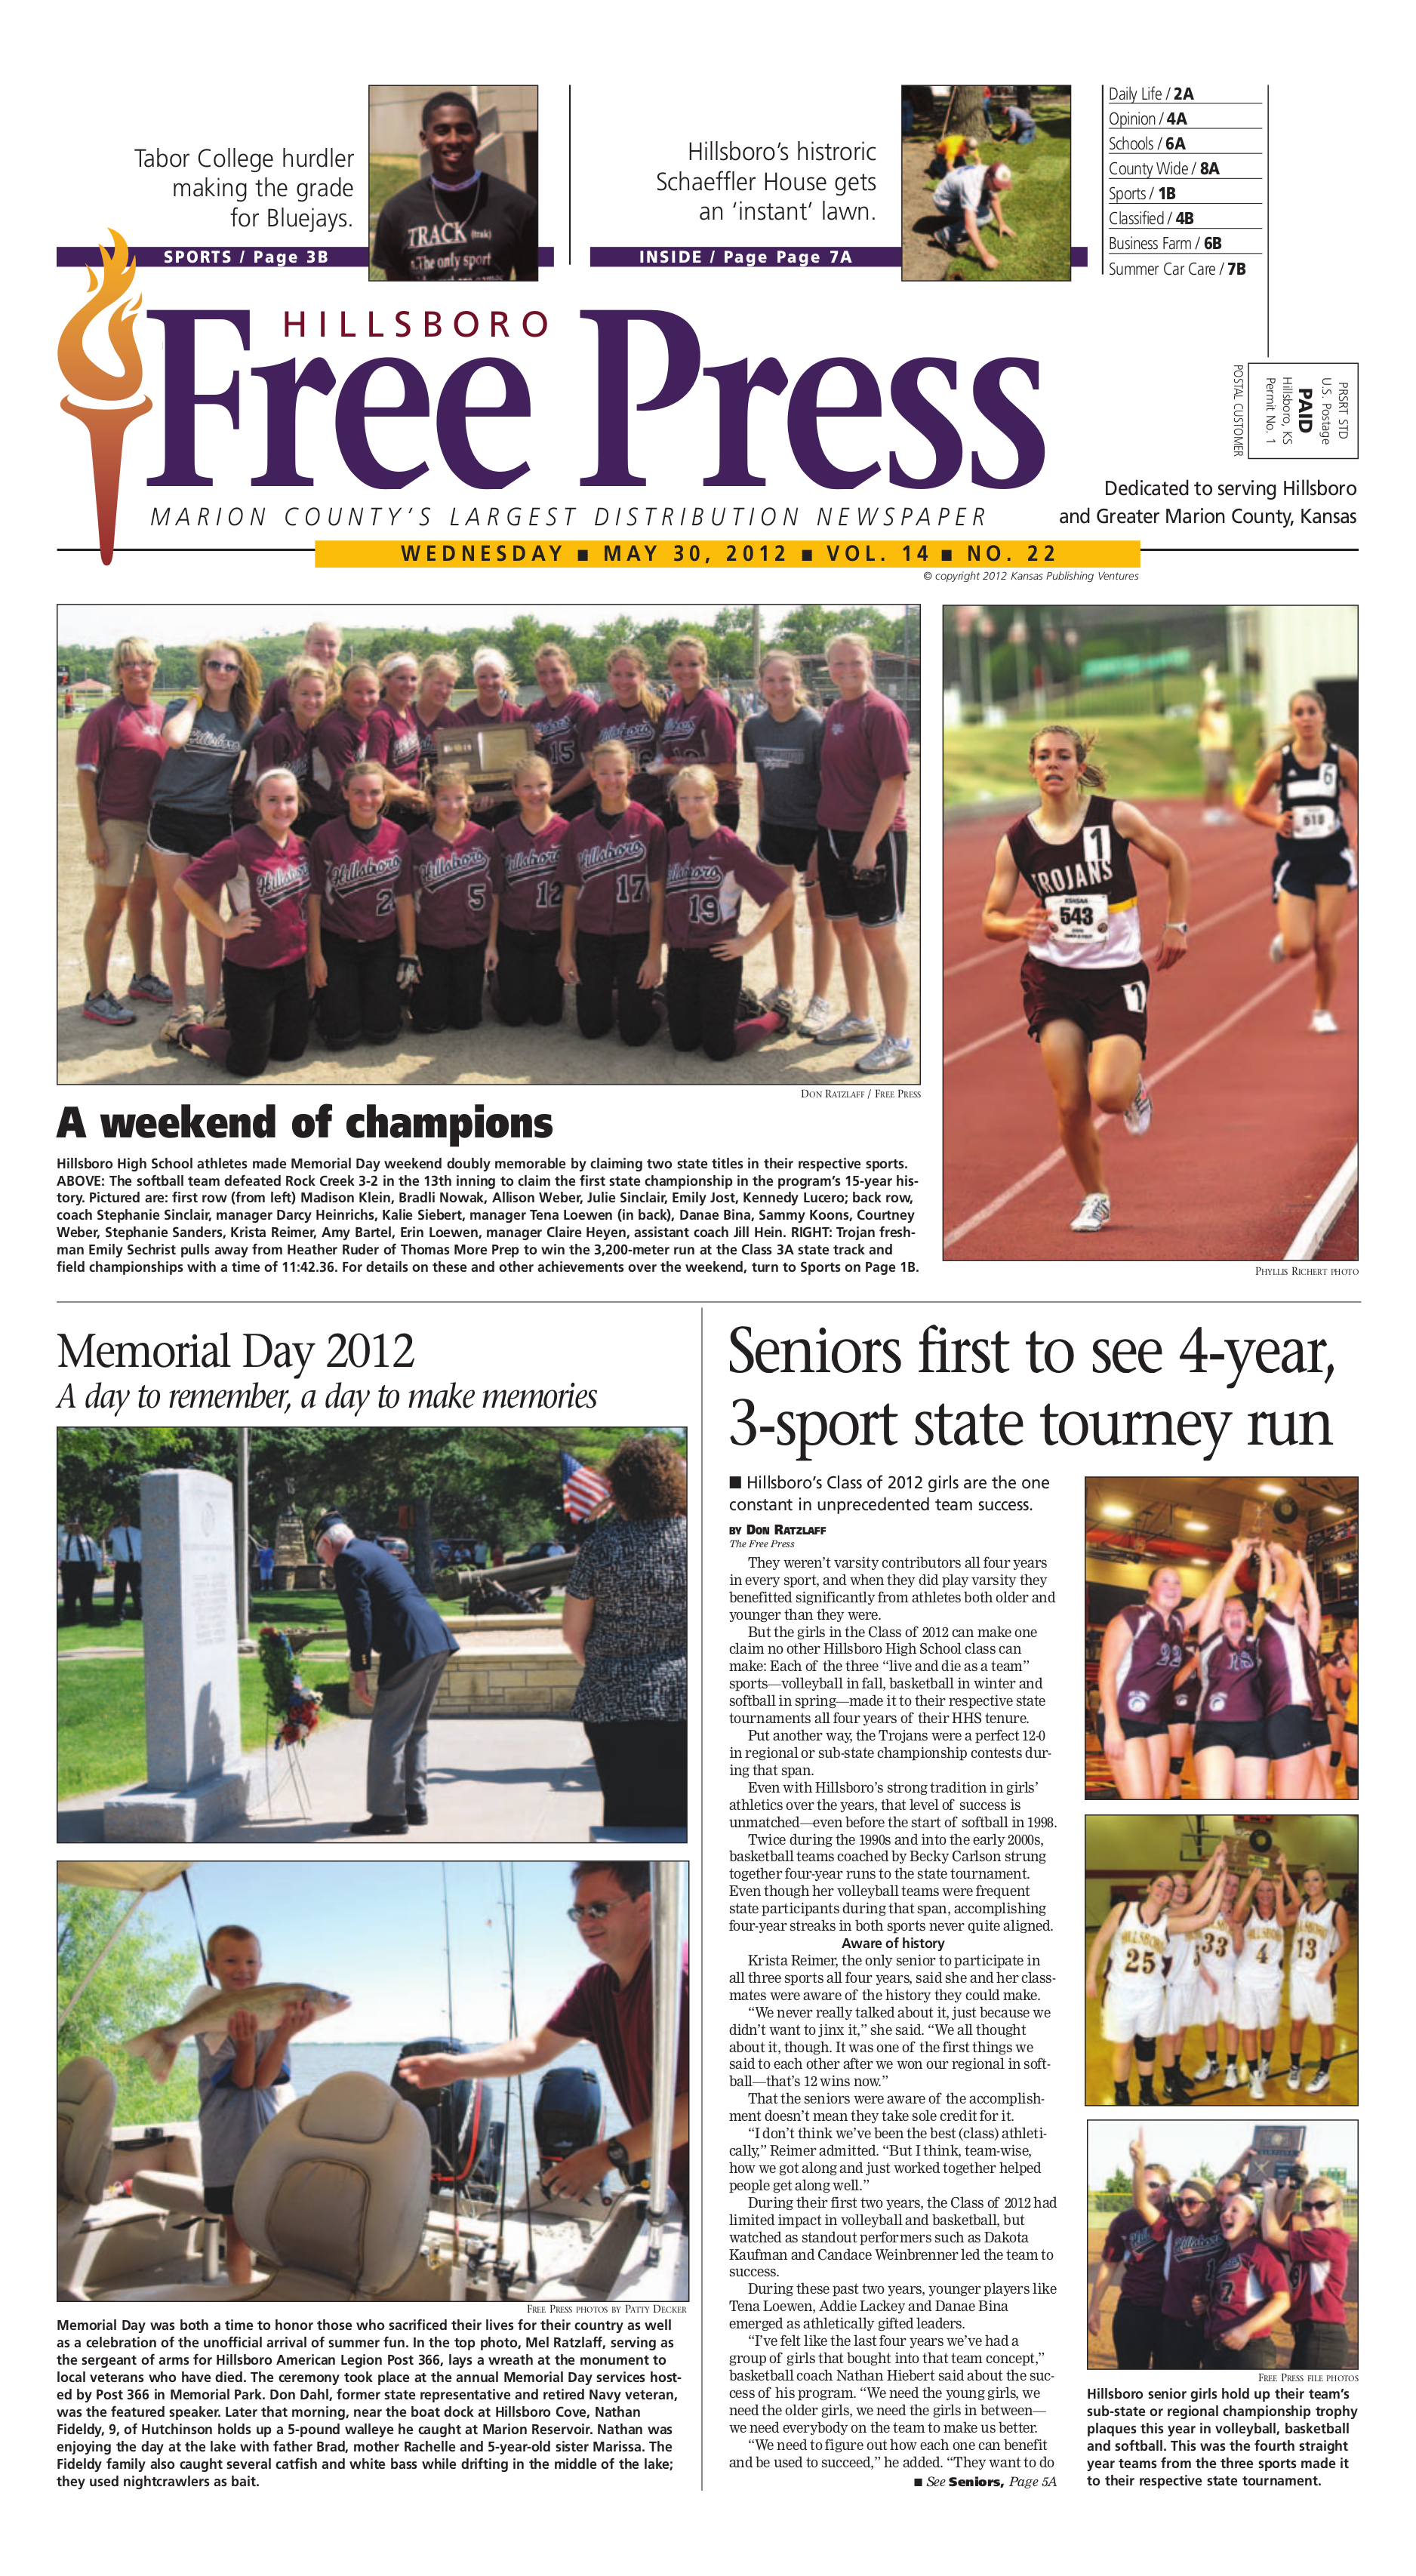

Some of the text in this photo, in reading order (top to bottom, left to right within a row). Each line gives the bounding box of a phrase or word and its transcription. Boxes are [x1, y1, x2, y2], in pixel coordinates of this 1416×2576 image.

[1110, 87, 1137, 102] Daily
[1142, 87, 1162, 100] Life
[1174, 88, 1194, 100] 2A
[1110, 112, 1155, 128] Opinion
[1167, 112, 1187, 125] 4A
[134, 148, 354, 172] Tabor College hurdler
[690, 141, 876, 160] Hillsboro’s histroric
[174, 177, 353, 202] making the grade
[657, 171, 876, 195] Schaeffler House gets
[231, 208, 352, 232] for Bluejays.
[700, 201, 875, 220] an ‘instant’ lawn.
[408, 222, 467, 248] TRACK
[165, 251, 230, 263] SPORTS
[254, 251, 297, 266] Page
[307, 251, 328, 263] 3B
[438, 252, 460, 270] only
[463, 253, 491, 270] sport
[640, 251, 700, 263] INSIDE
[725, 251, 767, 266] Page
[777, 251, 820, 266] Page
[830, 251, 851, 263] 7A
[1110, 263, 1159, 275] Summer
[1164, 263, 1184, 275] Car
[1189, 263, 1215, 275] Care
[1228, 263, 1245, 275] 7B
[285, 311, 547, 337] HILLSBORO
[146, 309, 1045, 489] Free Press
[1267, 378, 1276, 411] Permit
[1234, 365, 1243, 456] POSTAL CUSTOMER
[1282, 377, 1292, 444] Hillsboro, KS
[1299, 389, 1313, 432] PAID
[1319, 378, 1331, 445] U.S. Postage
[1339, 383, 1348, 439] PRSRT STD
[1267, 416, 1276, 432] No.
[1106, 480, 1356, 500] Dedicated to serving Hillsboro
[151, 507, 984, 525] MARION COUNTY’S LARGEST DISTRIBUTION NEWSPAPER
[1060, 508, 1356, 528] and Greater Marion County, Kansas
[401, 545, 1054, 563] WEDNESDAY MAY 30, 2012 VOL. 14 NO. 22
[936, 571, 980, 582] copyright
[1047, 571, 1094, 582] Publishing
[550, 741, 575, 765] 15
[1324, 765, 1334, 786] 6
[1090, 828, 1103, 860] 1
[617, 874, 647, 903] 17
[1031, 858, 1113, 897] TROJANS
[468, 884, 486, 910] 5
[536, 880, 562, 909] 12
[688, 894, 719, 924] 19
[1060, 907, 1094, 925] 543
[1131, 983, 1143, 1011] 1
[56, 1103, 553, 1146] A weekend of champions
[57, 1332, 414, 1379] Memorial Day 2012
[730, 1325, 1334, 1389] Seniors first to see 4-year,
[55, 1382, 597, 1417] A day to remember, a day to make memories
[731, 1399, 1333, 1460] 3-sport state tourney run
[1156, 1642, 1182, 1668] 22
[842, 1937, 944, 1951] Aware of history
[1202, 1932, 1229, 1958] 33
[1255, 1942, 1269, 1963] 4
[1296, 1937, 1318, 1961] 13
[1124, 1947, 1156, 1974] 25
[1221, 2281, 1234, 2303] 7
[57, 2476, 85, 2489] they
[90, 2476, 119, 2486] used
[124, 2476, 209, 2489] nightcrawlers
[232, 2476, 259, 2486] bait.
[927, 2476, 1057, 2488] See Seniors, Page 5A
